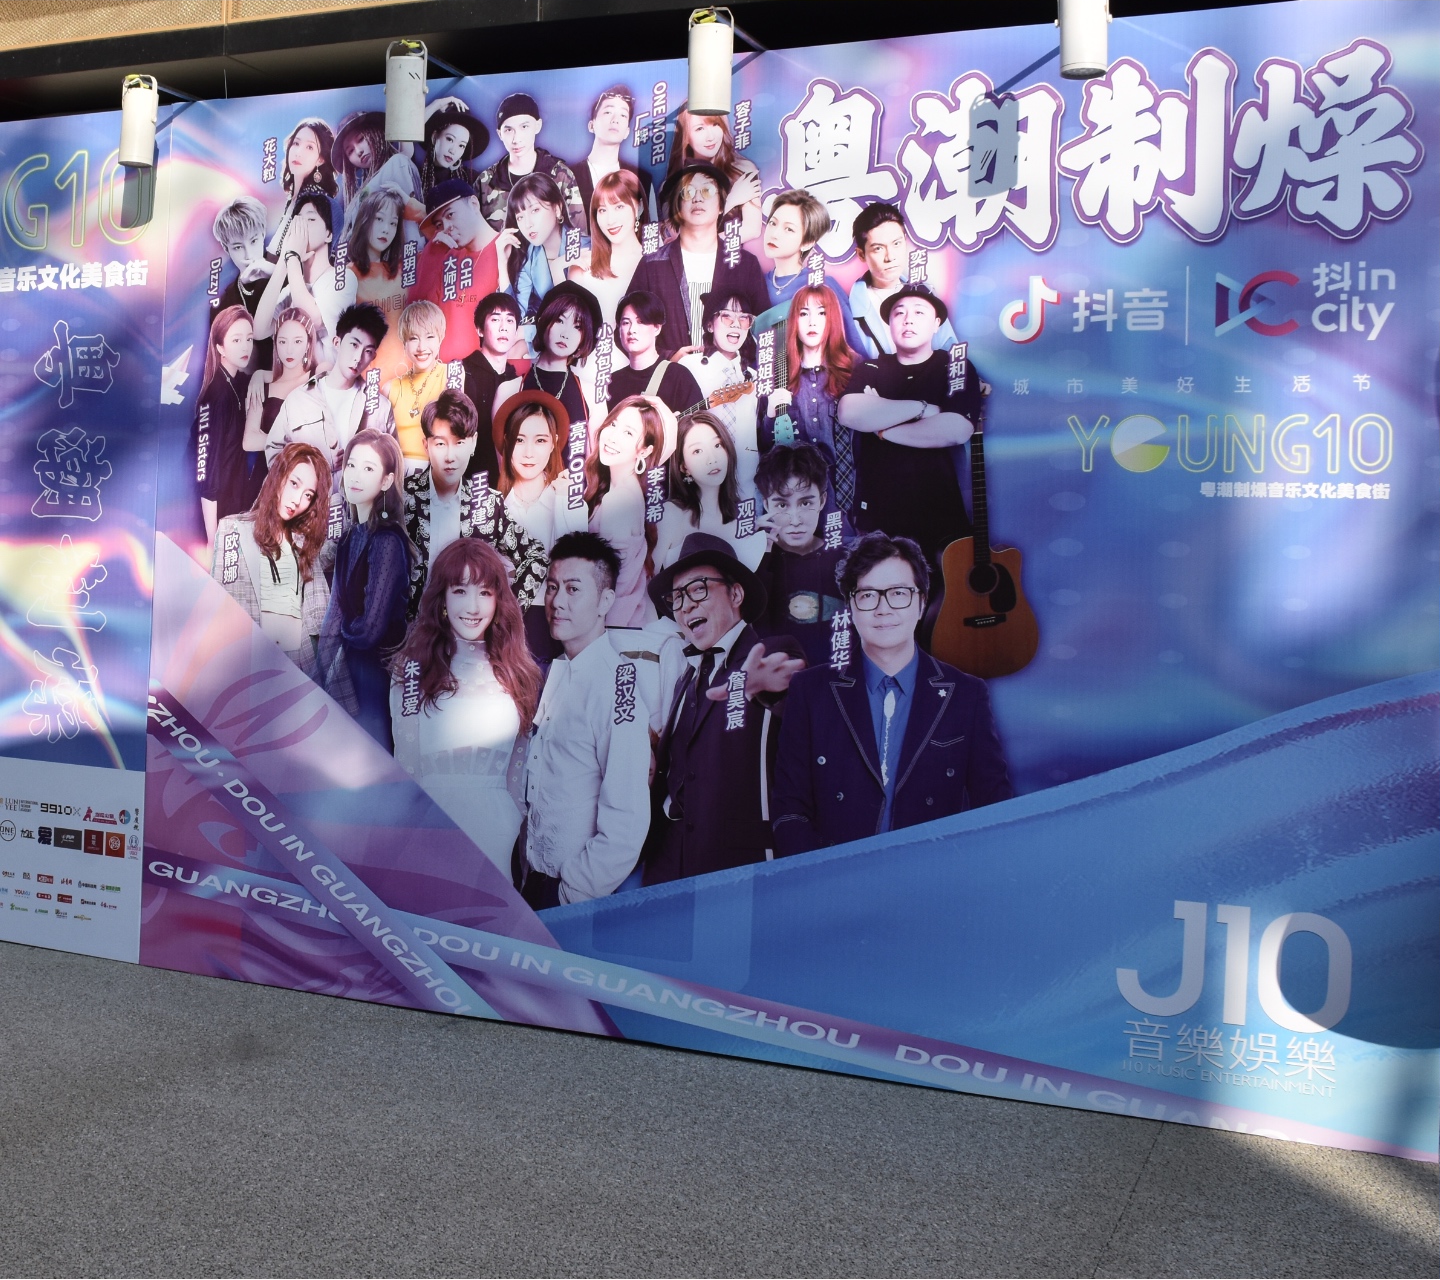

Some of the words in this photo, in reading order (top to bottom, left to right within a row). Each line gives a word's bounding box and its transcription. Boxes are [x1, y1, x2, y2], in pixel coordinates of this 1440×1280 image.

[653, 81, 668, 115] ONE
[652, 117, 668, 165] MORE
[735, 101, 751, 150] 容子菲
[764, 40, 1418, 254] 粤潮制燥
[262, 138, 277, 182] 花大粒
[566, 227, 581, 261] 芮芮
[643, 222, 659, 255] 璇璇
[725, 218, 742, 268] 叶迪卡
[0, 259, 149, 292] 音乐文化美食街
[206, 256, 222, 296] Dizzy
[402, 242, 417, 288] 陈玥廷
[442, 256, 457, 302] 大师兄
[460, 258, 473, 289] CHE
[909, 249, 928, 283] 奕凯
[1313, 261, 1396, 298] 抖in
[1072, 288, 1169, 333] 抖音
[1311, 293, 1397, 340] city
[595, 323, 614, 404] 小笼包乐队
[756, 330, 775, 398] 碳酸姐妹
[948, 343, 967, 396] 何和声
[1013, 374, 1371, 395] 城市美好生活节
[365, 368, 382, 415] 陈俊宇
[196, 433, 208, 482] Sisters
[471, 471, 488, 527] 王子建
[646, 466, 665, 523] 李泳希
[1200, 481, 1390, 500] 粤潮制燥音乐文化美食街
[327, 505, 343, 539] 王晴
[736, 501, 755, 538] 观辰
[824, 511, 843, 550] 黑泽
[222, 532, 240, 584] 欧静娜
[830, 610, 850, 671] 林健华
[402, 661, 420, 716] 朱主爱
[616, 663, 636, 724] 梁汉文
[726, 671, 746, 731] 詹昊宸
[223, 778, 286, 834] DOU
[279, 828, 315, 862] IN
[1116, 900, 1353, 1034] J10
[412, 926, 500, 962] DOU
[509, 951, 552, 976] IN
[562, 966, 861, 1050] GUANGZHOU
[894, 1044, 1008, 1084] DOU
[1022, 1072, 1072, 1100] IN
[1120, 1059, 1143, 1074] J10
[1146, 1063, 1197, 1081] MUSIC
[1201, 1069, 1336, 1098] ENTERTAINMENT
